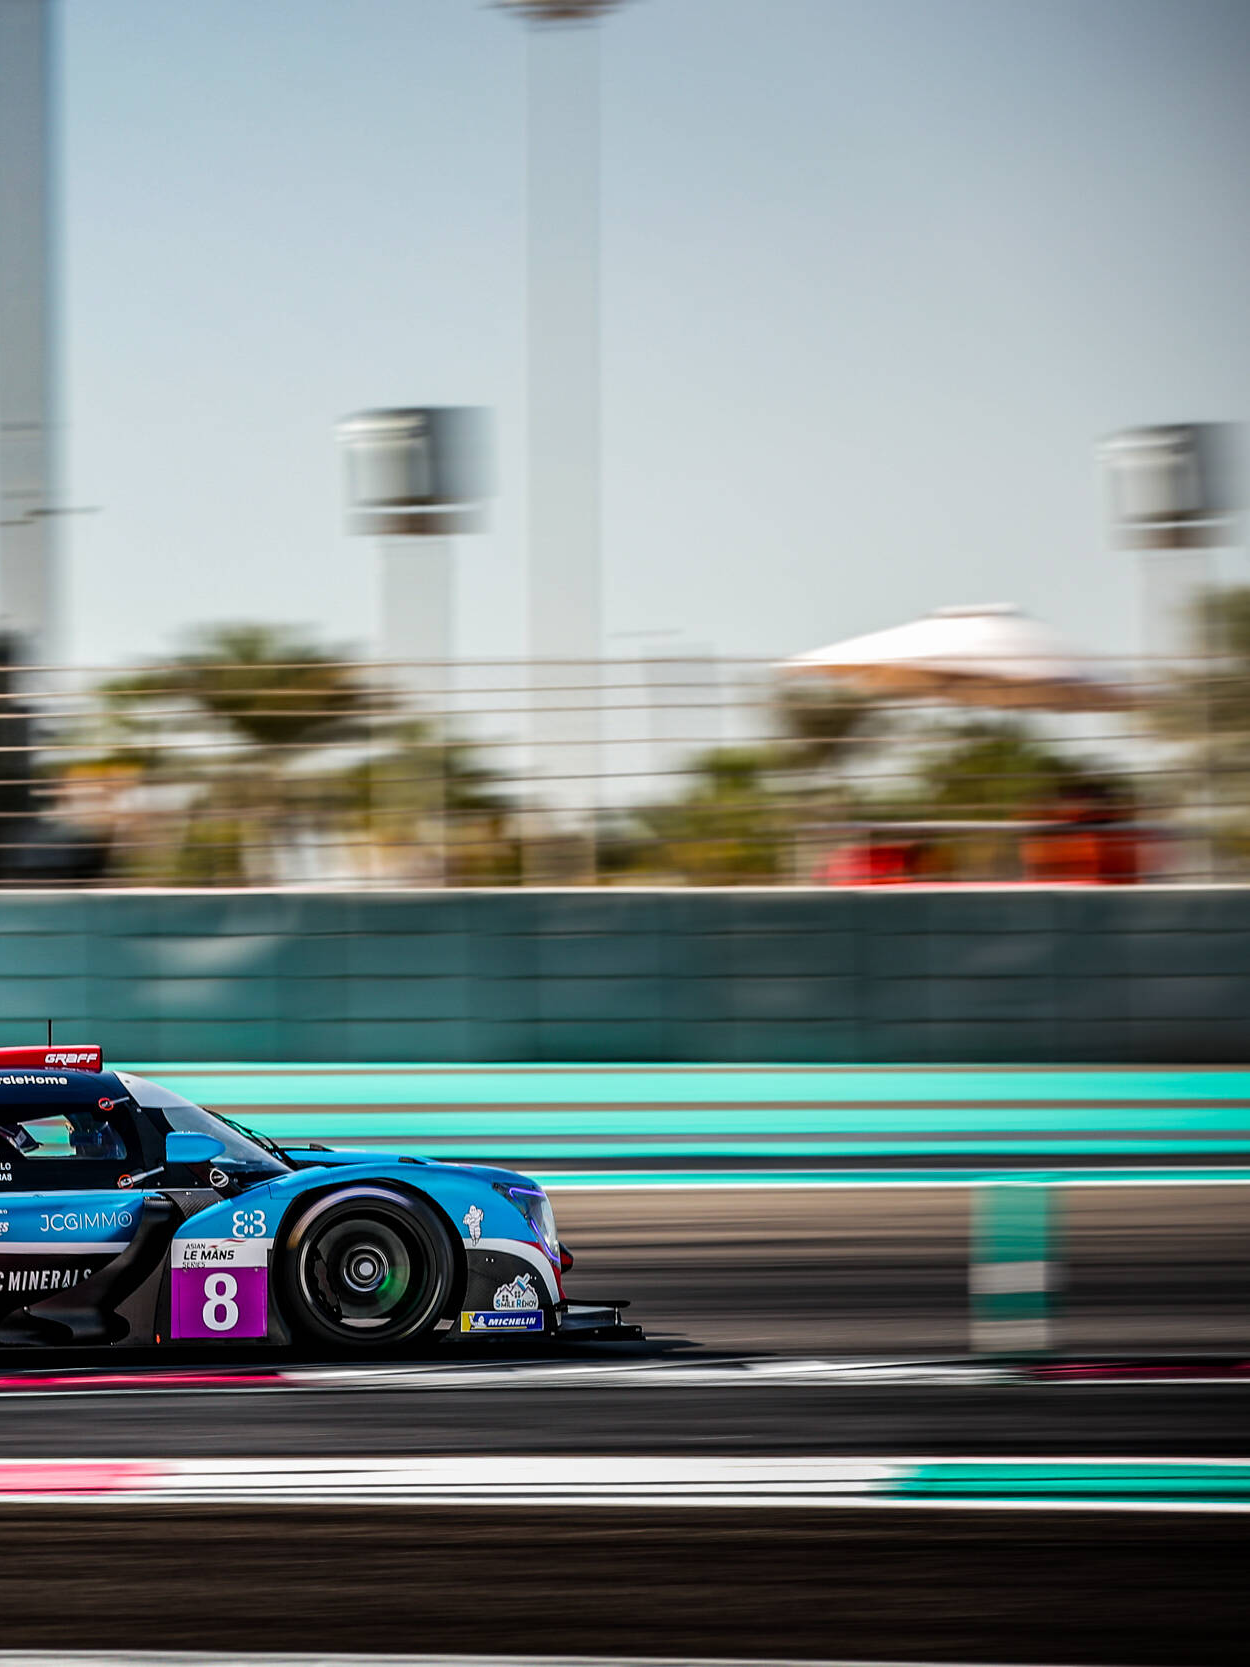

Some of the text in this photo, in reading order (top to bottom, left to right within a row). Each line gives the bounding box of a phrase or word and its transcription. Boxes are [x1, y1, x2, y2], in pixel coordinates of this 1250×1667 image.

[45, 1053, 98, 1065] GRAFF
[183, 1250, 235, 1261] LE MANS
[202, 1272, 239, 1331] 8
[488, 1317, 537, 1326] MICHELIN
